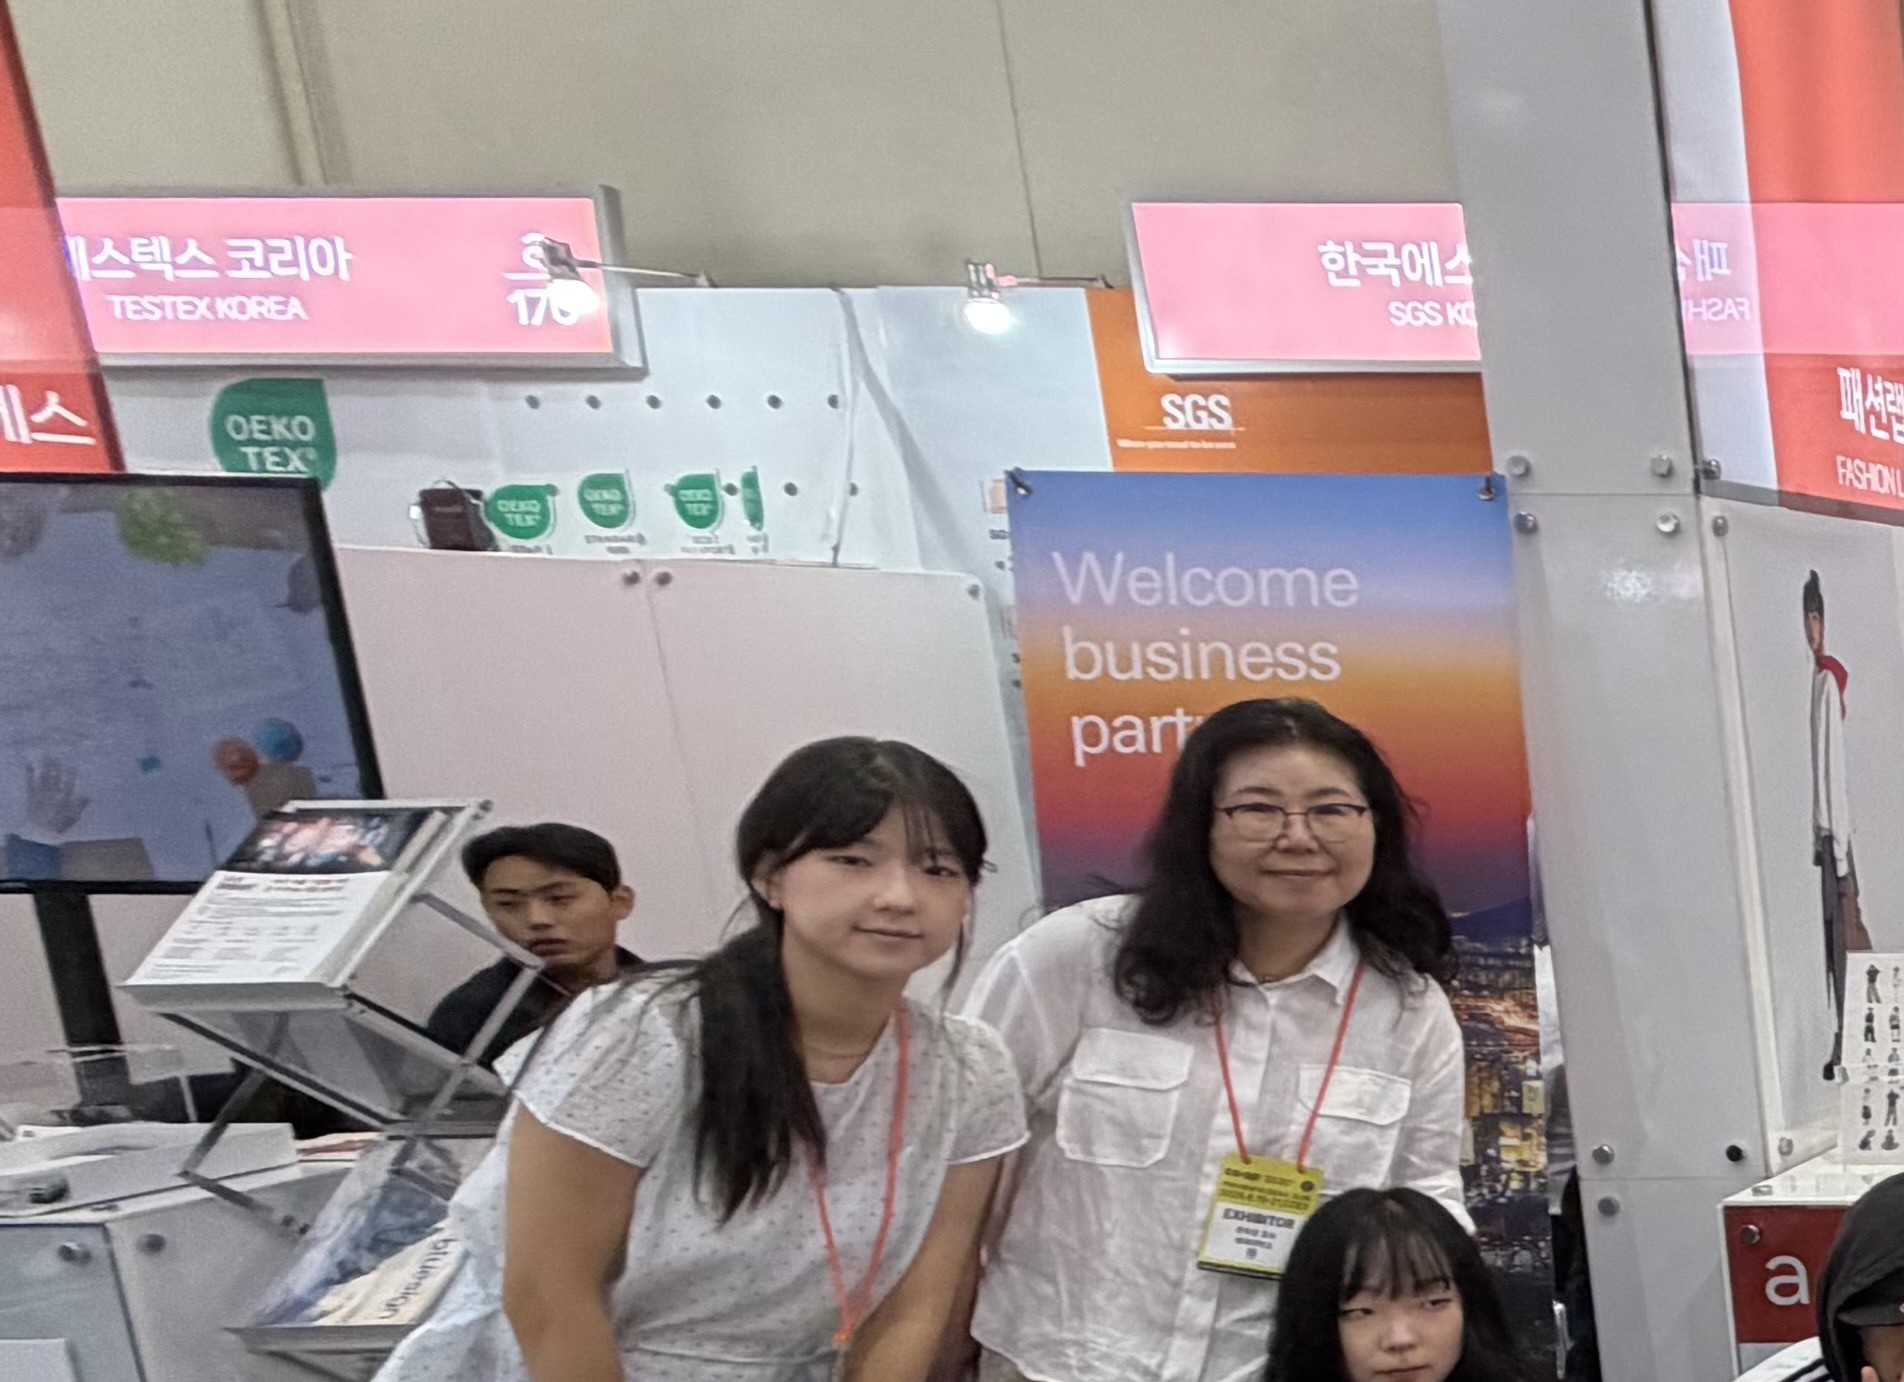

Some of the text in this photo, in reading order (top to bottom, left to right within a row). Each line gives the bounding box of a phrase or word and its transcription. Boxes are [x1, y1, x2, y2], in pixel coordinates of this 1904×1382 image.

[223, 235, 356, 282] 코리아
[105, 294, 309, 321] TESTEX KOREA
[1387, 300, 1444, 327] SGS
[223, 414, 316, 442] OEKO
[1160, 393, 1234, 431] SGS
[1836, 455, 1897, 496] FASHION
[1051, 550, 1359, 607] Welcome
[1062, 626, 1342, 683] business
[1071, 706, 1204, 768] part
[1764, 1253, 1811, 1306] a
